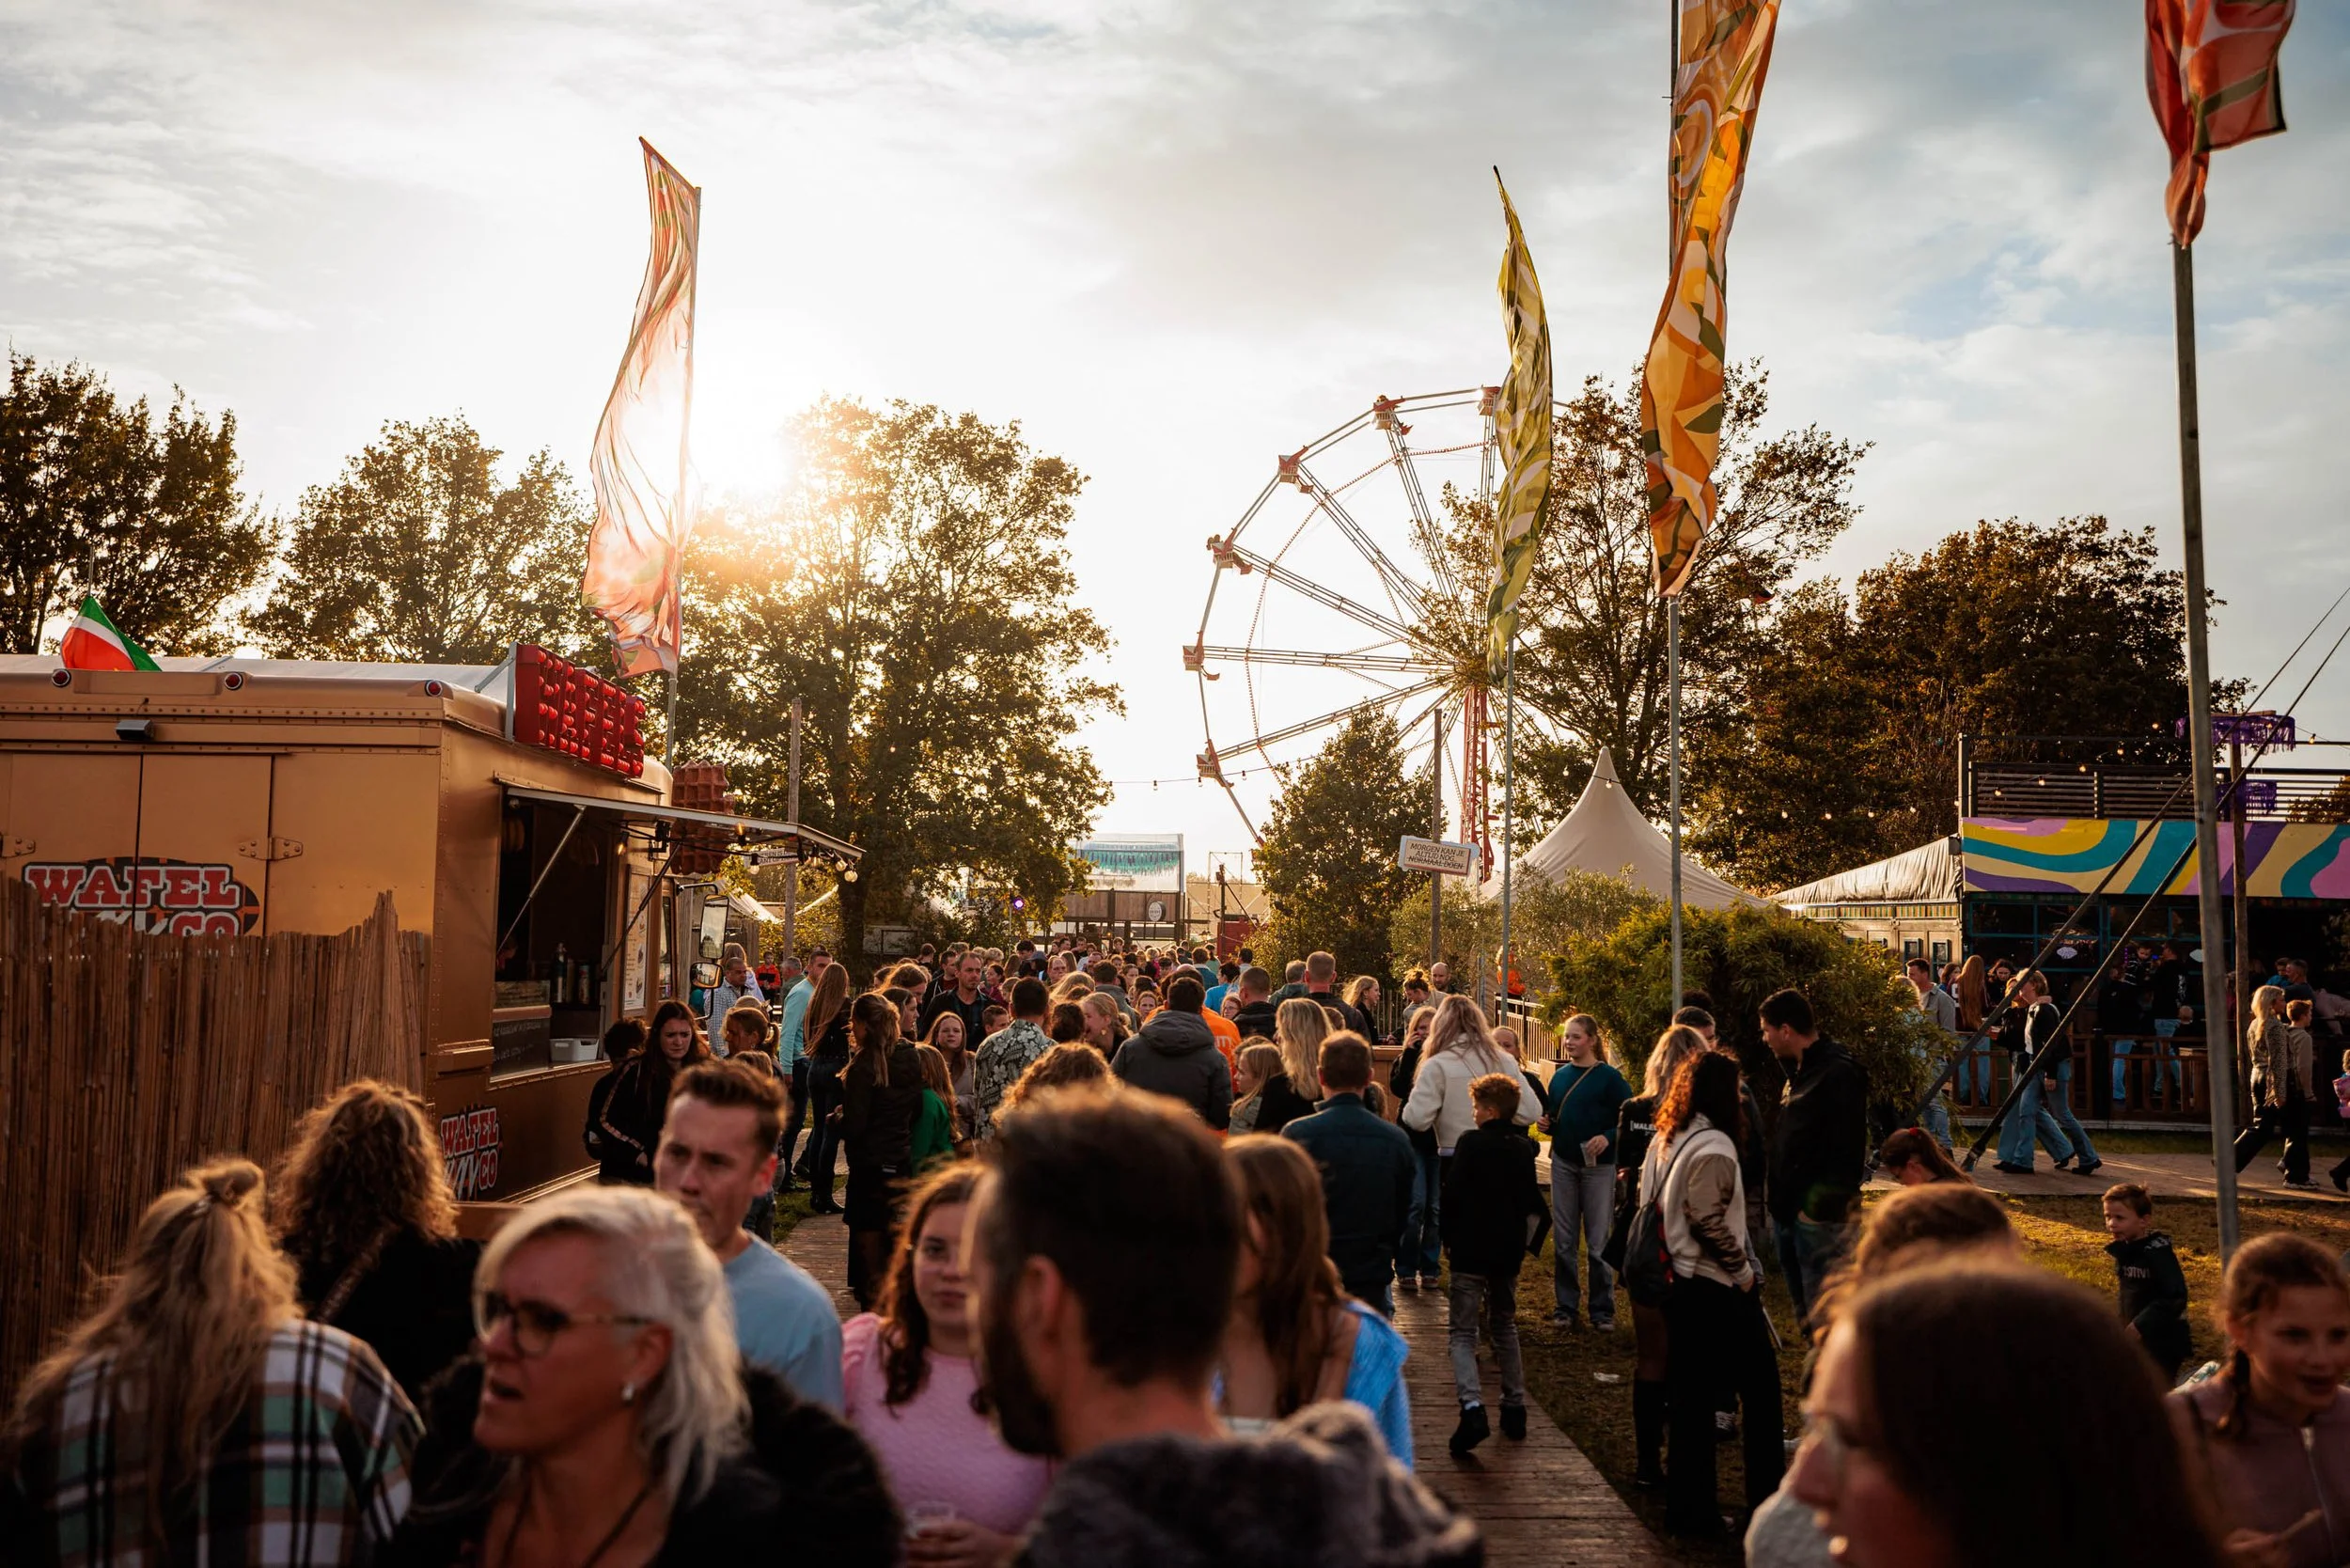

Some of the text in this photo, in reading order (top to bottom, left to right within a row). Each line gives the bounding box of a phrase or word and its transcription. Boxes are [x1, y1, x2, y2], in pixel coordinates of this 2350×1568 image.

[1408, 856, 1442, 866] NORMAAL
[1410, 843, 1440, 853] MORGEN
[24, 865, 241, 909] WAFEL
[441, 1107, 499, 1159] WAFEL
